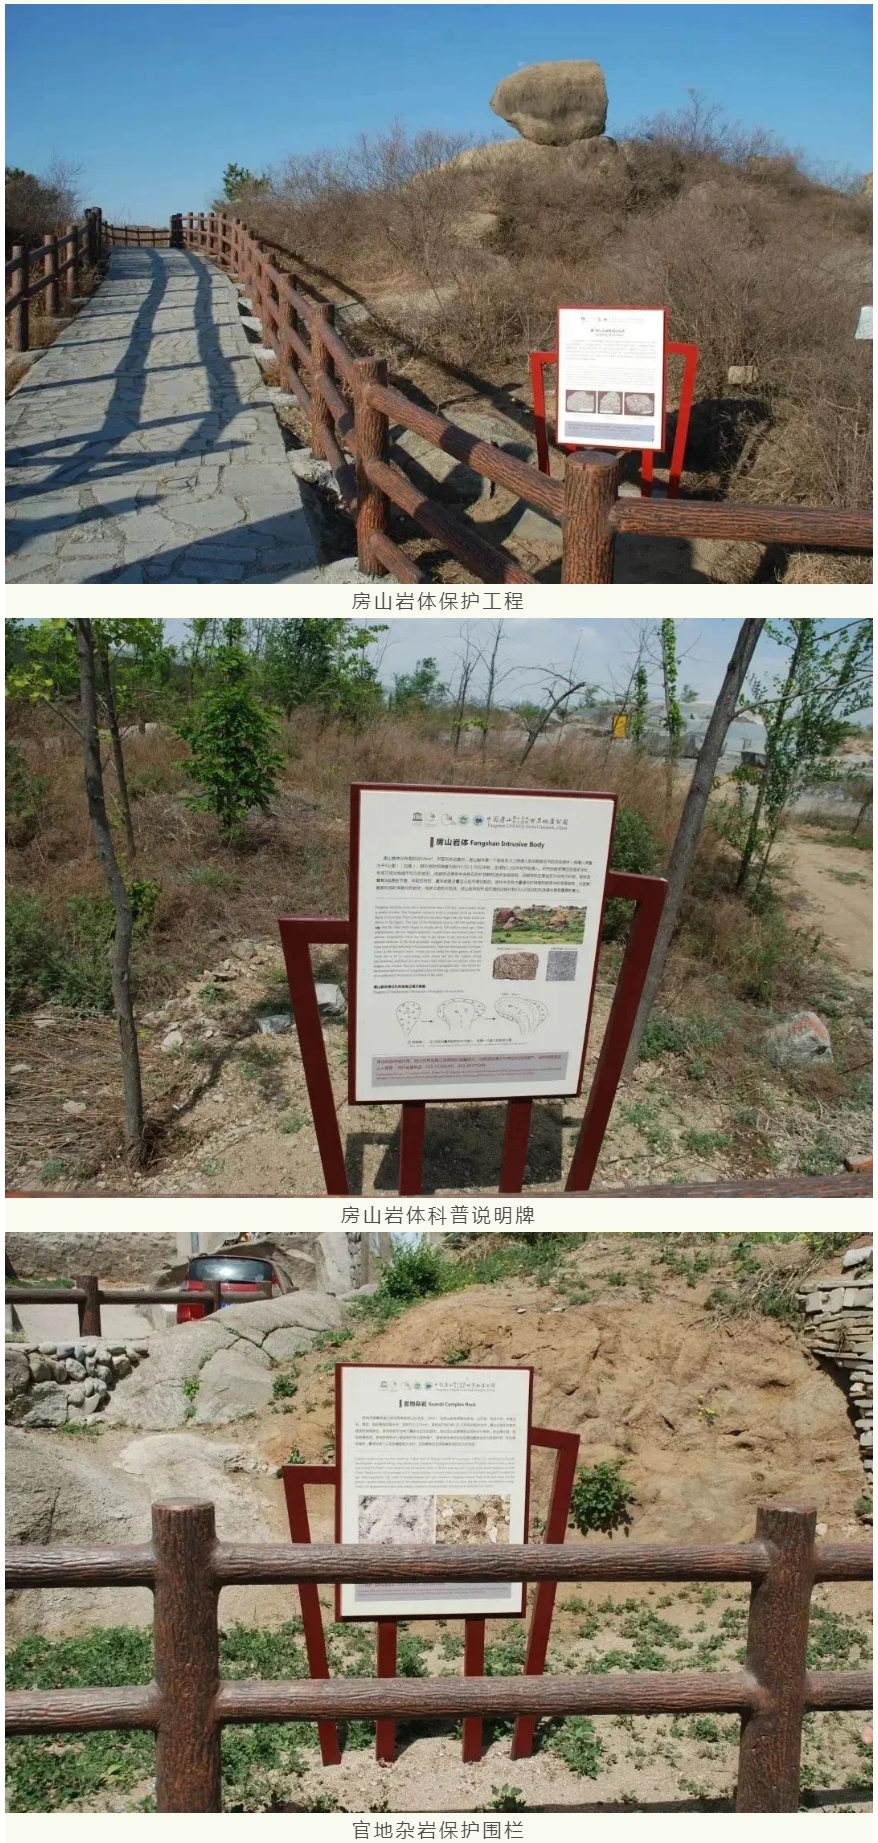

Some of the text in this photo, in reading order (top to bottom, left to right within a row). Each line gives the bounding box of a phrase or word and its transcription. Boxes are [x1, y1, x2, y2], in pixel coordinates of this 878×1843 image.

[436, 837, 545, 849] 房山岩体 Fangshan Intrusive Body
[445, 1401, 465, 1409] Complex
